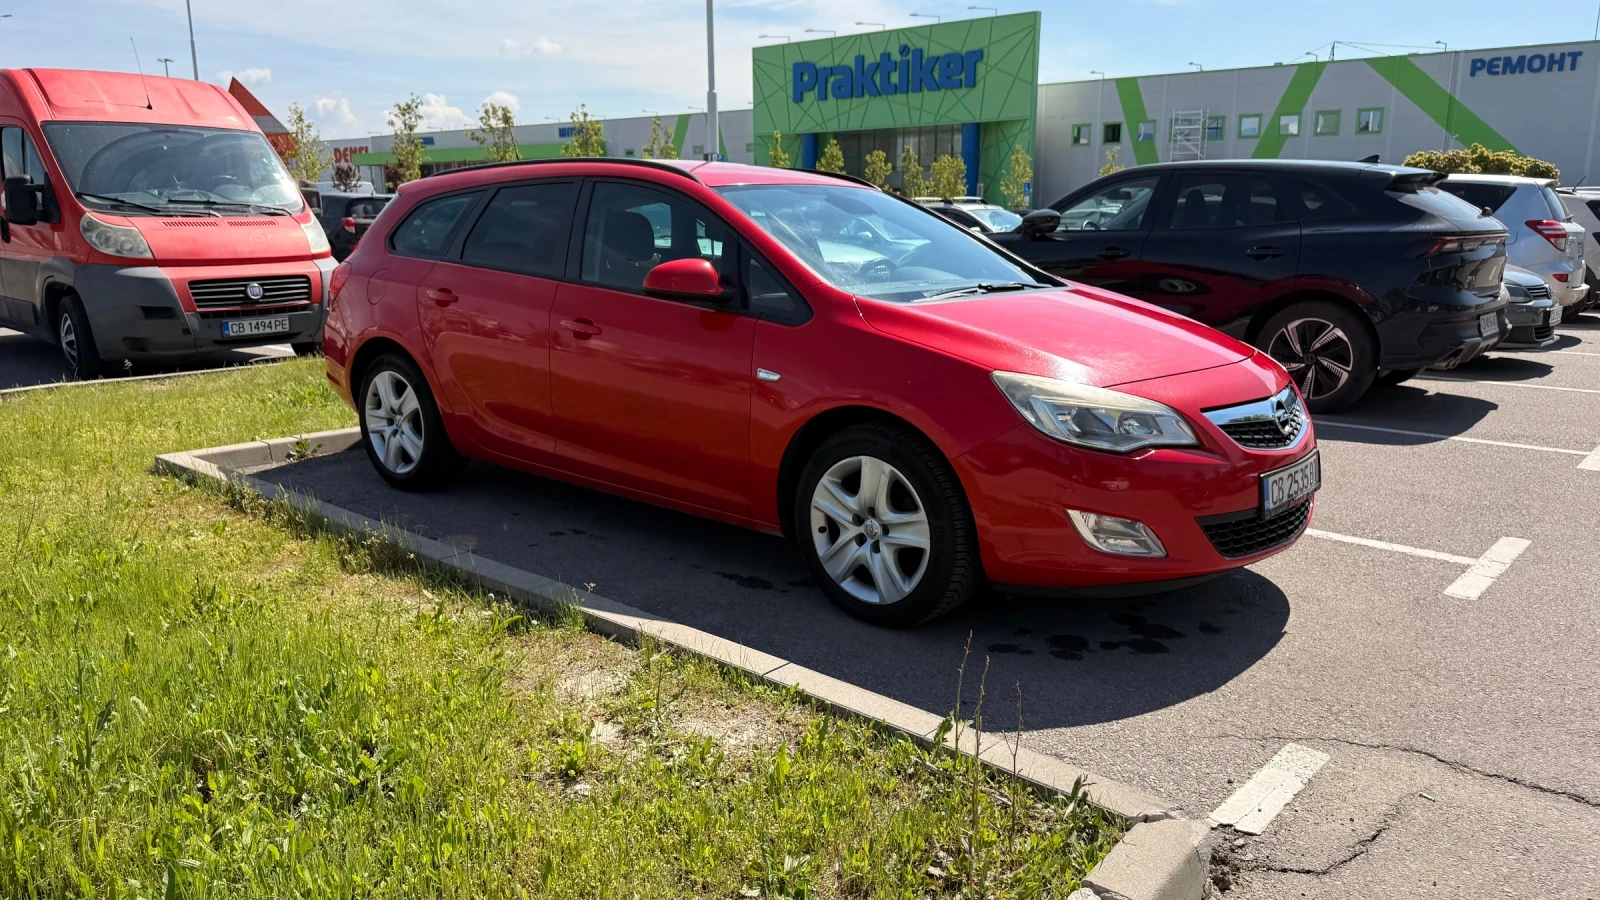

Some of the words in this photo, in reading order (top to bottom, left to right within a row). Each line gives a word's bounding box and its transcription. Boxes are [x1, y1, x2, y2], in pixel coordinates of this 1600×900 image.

[792, 44, 984, 103] Praktiker
[1469, 51, 1583, 77] РЕМОНТ
[231, 323, 245, 334] CB
[248, 320, 273, 333] 1494
[274, 319, 288, 330] PE
[1271, 476, 1285, 505] CB
[1287, 464, 1309, 498] 2535
